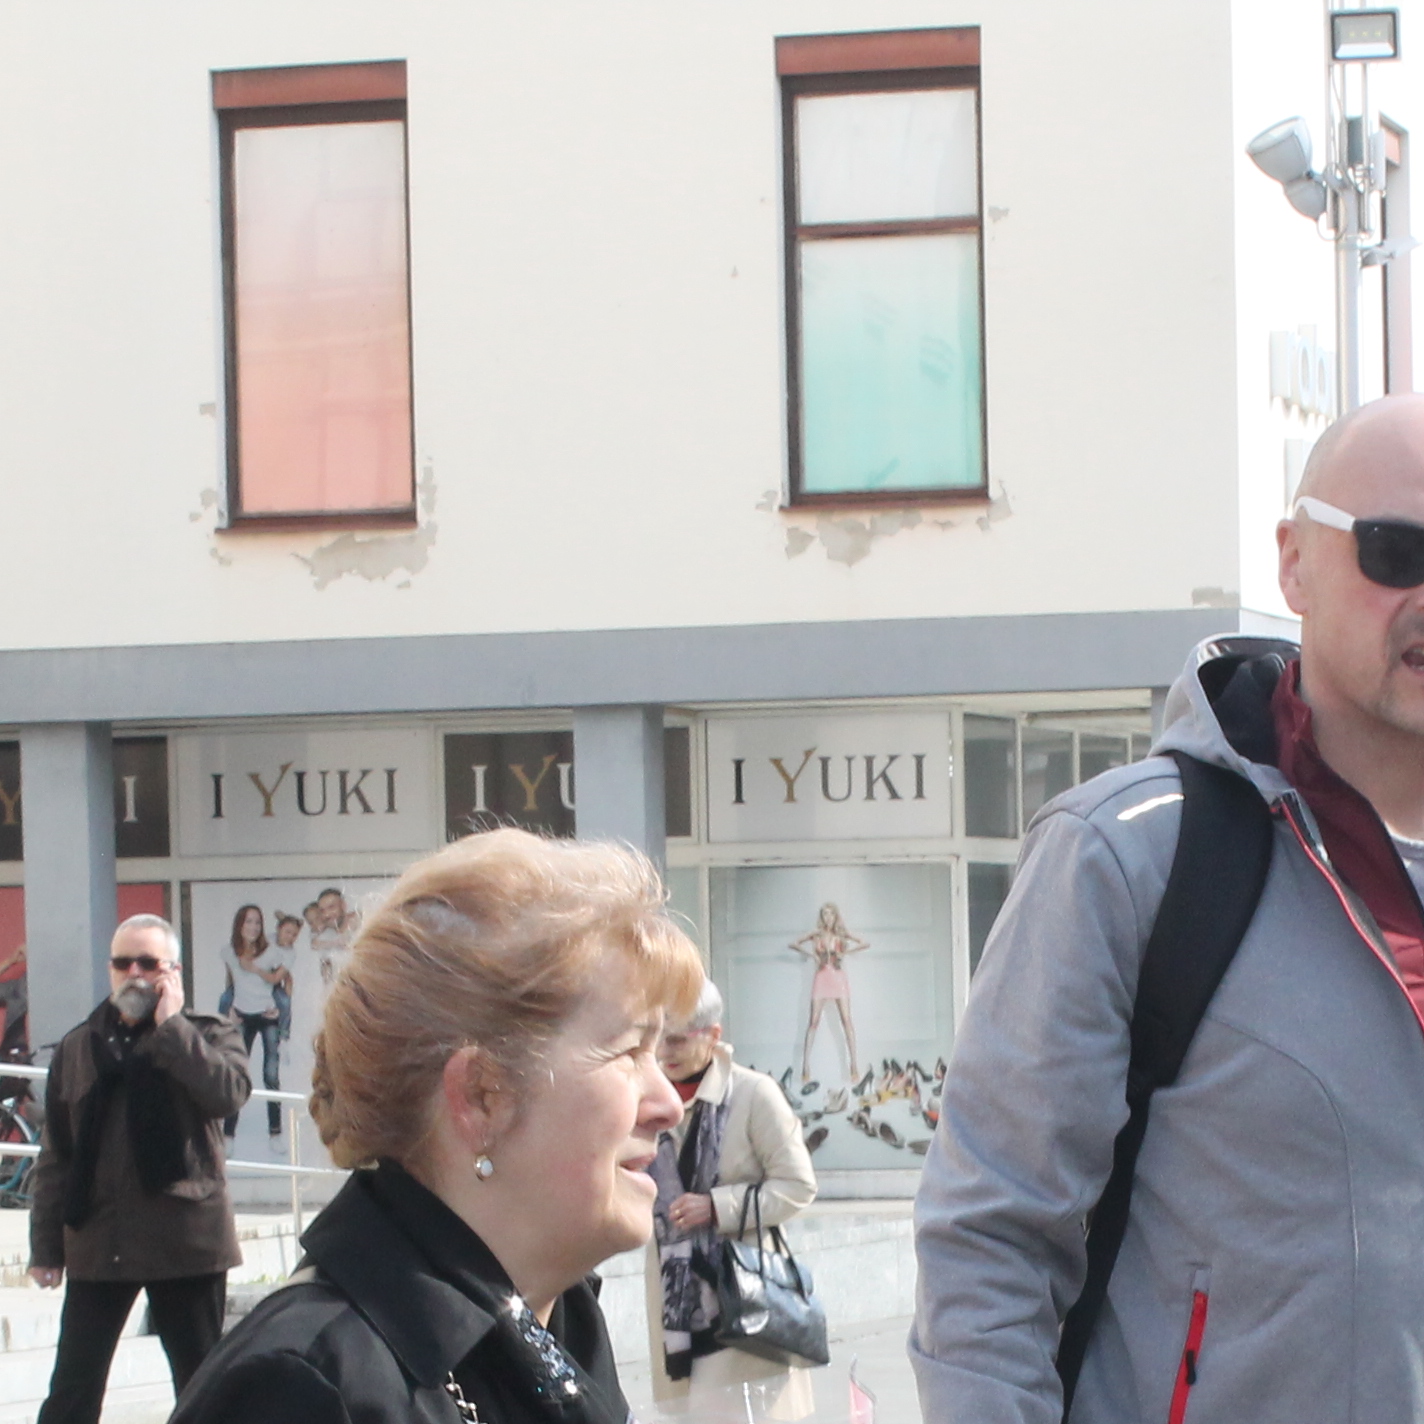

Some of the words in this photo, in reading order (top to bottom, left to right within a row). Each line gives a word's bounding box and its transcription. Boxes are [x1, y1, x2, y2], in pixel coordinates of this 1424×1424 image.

[211, 773, 225, 819] I
[247, 761, 399, 818] YUKI
[731, 758, 745, 805] I
[769, 746, 926, 804] YUKI
